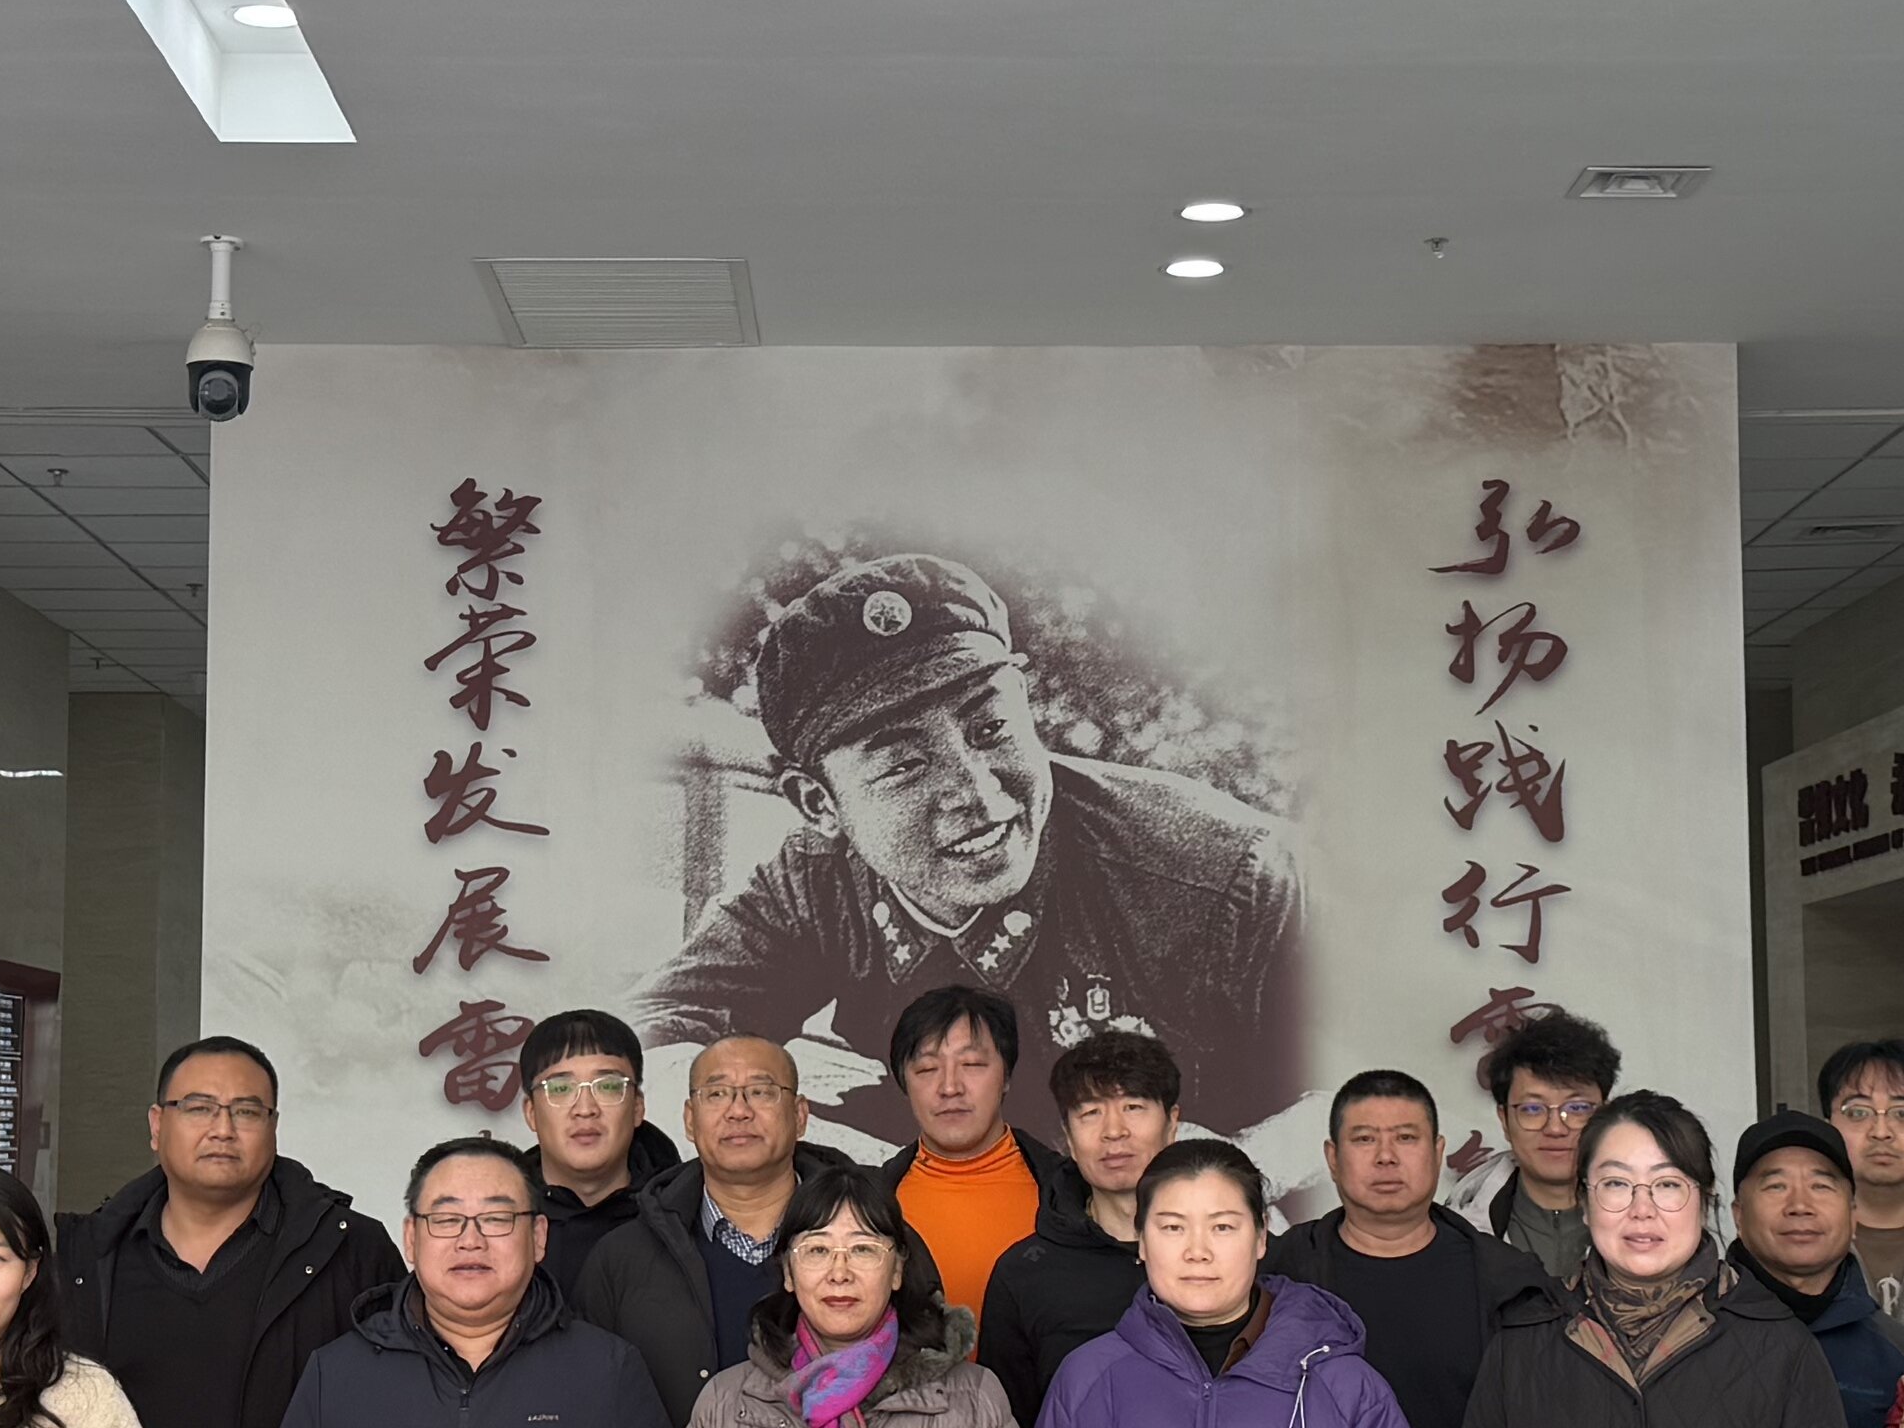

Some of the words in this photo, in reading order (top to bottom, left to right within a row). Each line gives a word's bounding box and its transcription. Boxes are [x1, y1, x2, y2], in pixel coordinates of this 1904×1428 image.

[412, 478, 550, 1139] 繁荣发展雷
